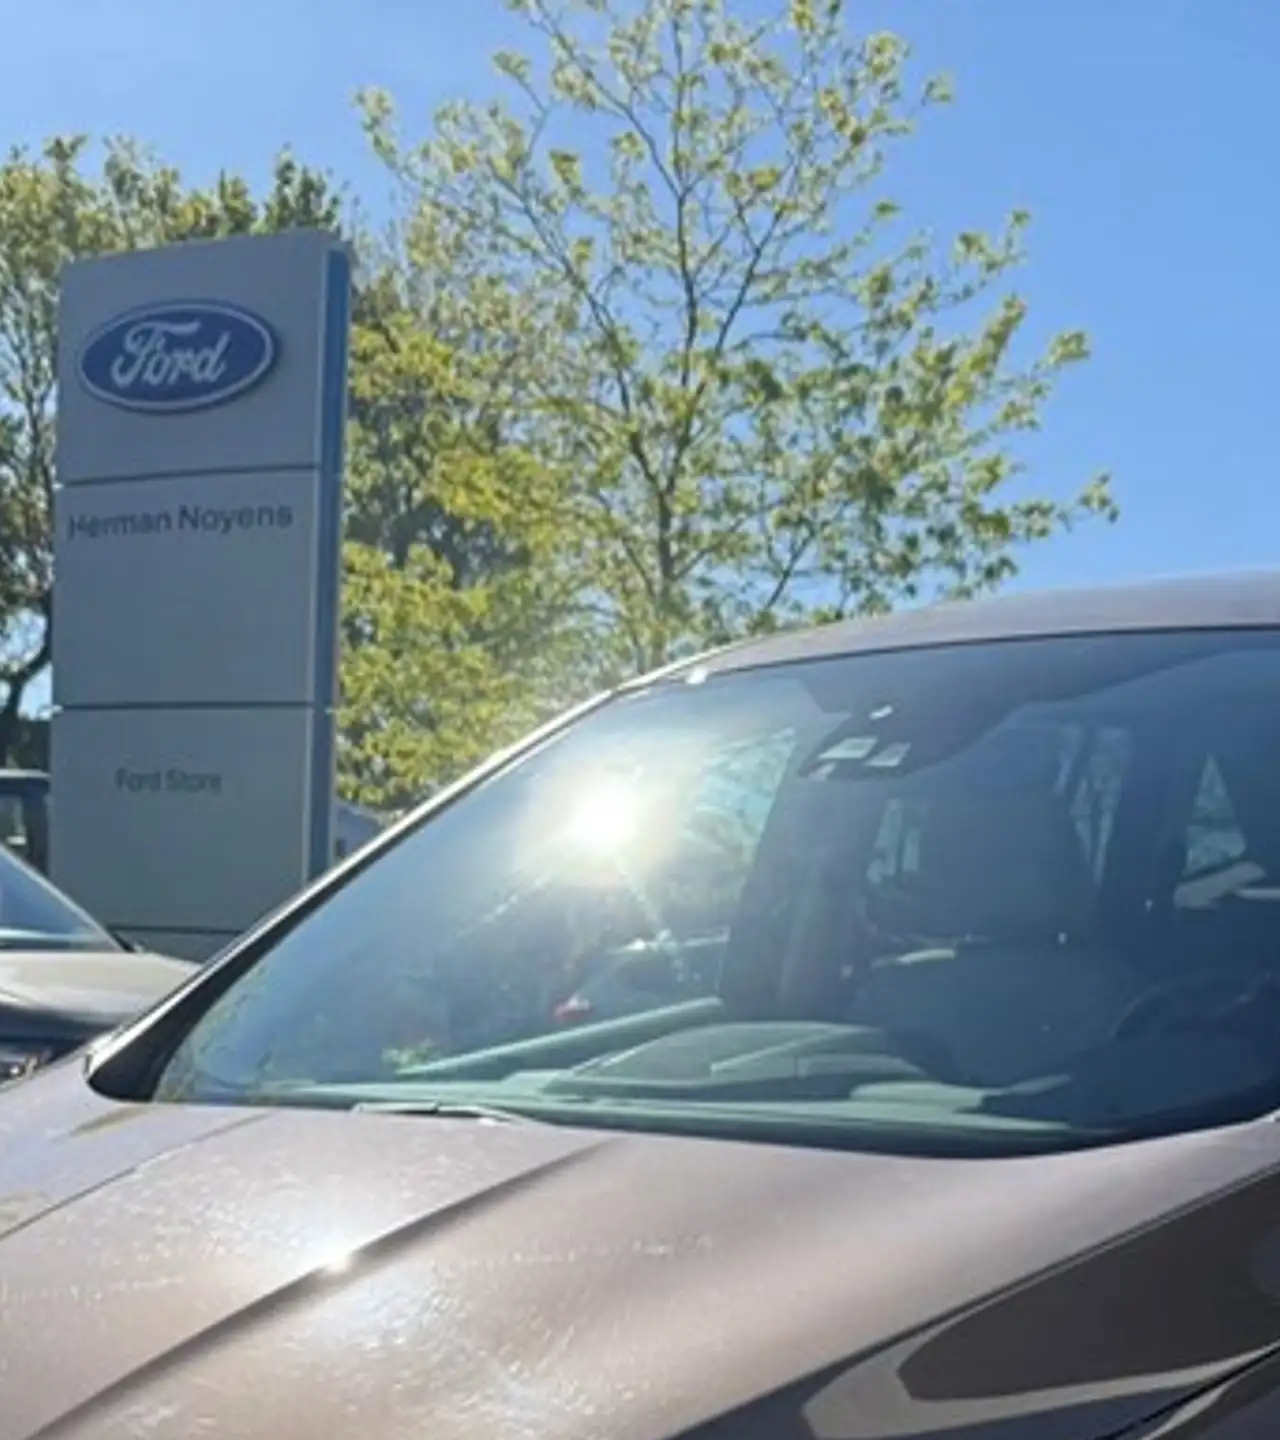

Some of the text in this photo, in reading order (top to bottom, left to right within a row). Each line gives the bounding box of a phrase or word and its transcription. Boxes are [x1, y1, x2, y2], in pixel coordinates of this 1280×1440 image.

[111, 319, 230, 387] Ford
[69, 504, 293, 538] Herman Noyens
[115, 767, 223, 794] Ford Store
